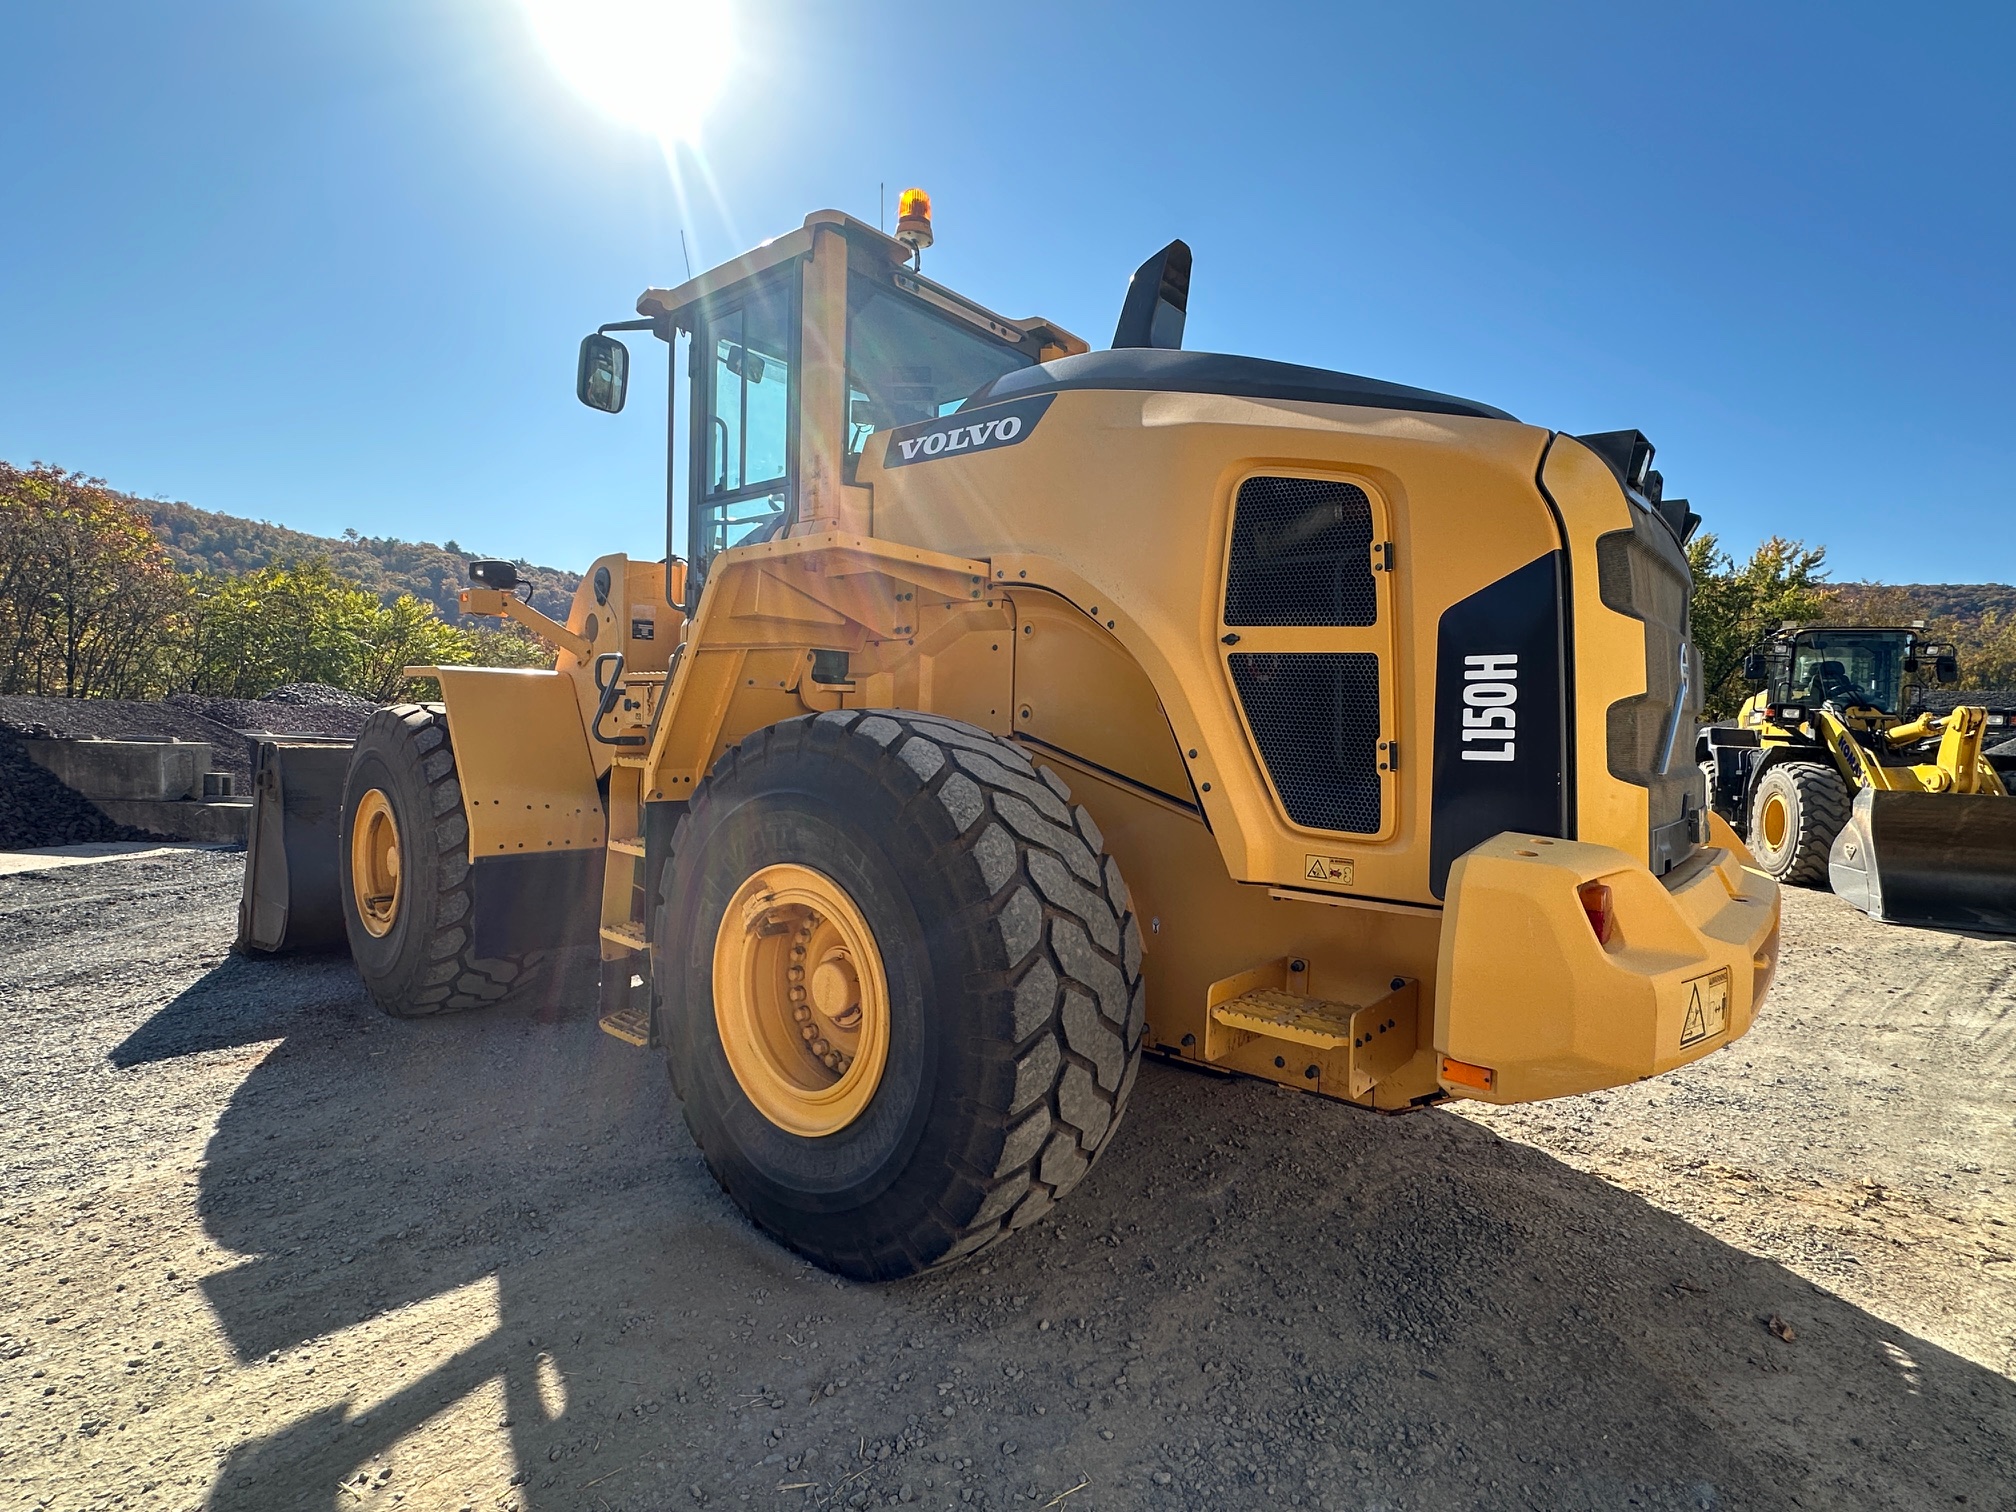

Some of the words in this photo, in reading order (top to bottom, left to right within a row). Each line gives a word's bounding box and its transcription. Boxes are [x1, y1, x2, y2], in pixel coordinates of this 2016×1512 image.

[898, 416, 1022, 459] VOLVO
[1461, 654, 1518, 762] L150H
[1838, 734, 1873, 788] KOMATS
